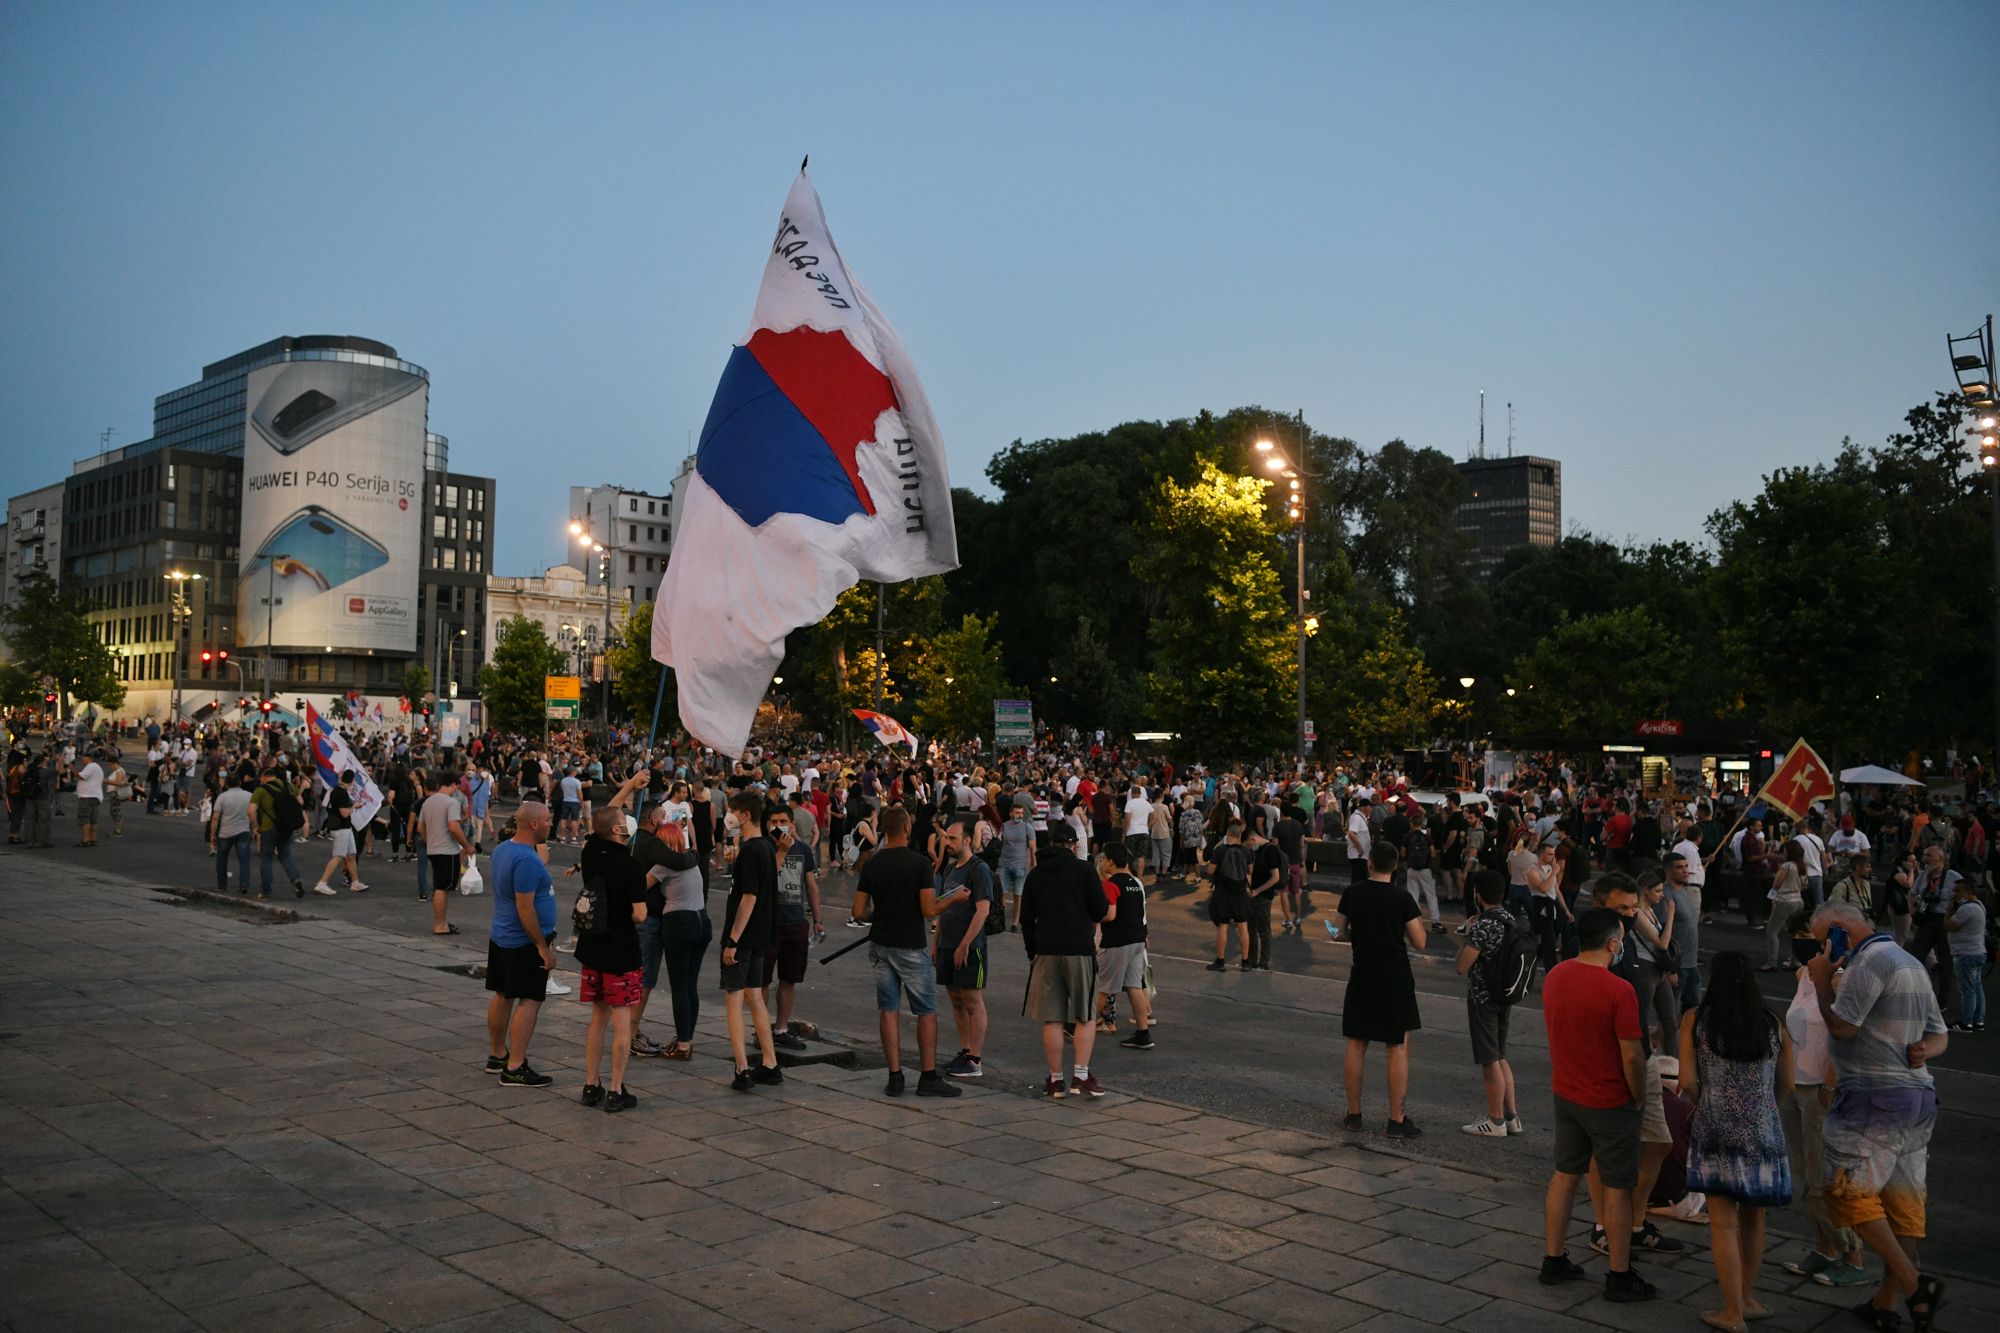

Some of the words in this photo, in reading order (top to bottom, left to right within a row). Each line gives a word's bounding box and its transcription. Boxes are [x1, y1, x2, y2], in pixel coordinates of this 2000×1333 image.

[249, 471, 298, 492] HUAWEI
[306, 471, 339, 488] P40
[346, 473, 390, 495] Serija
[398, 480, 416, 498] 5G
[368, 605, 407, 618] AppGallery
